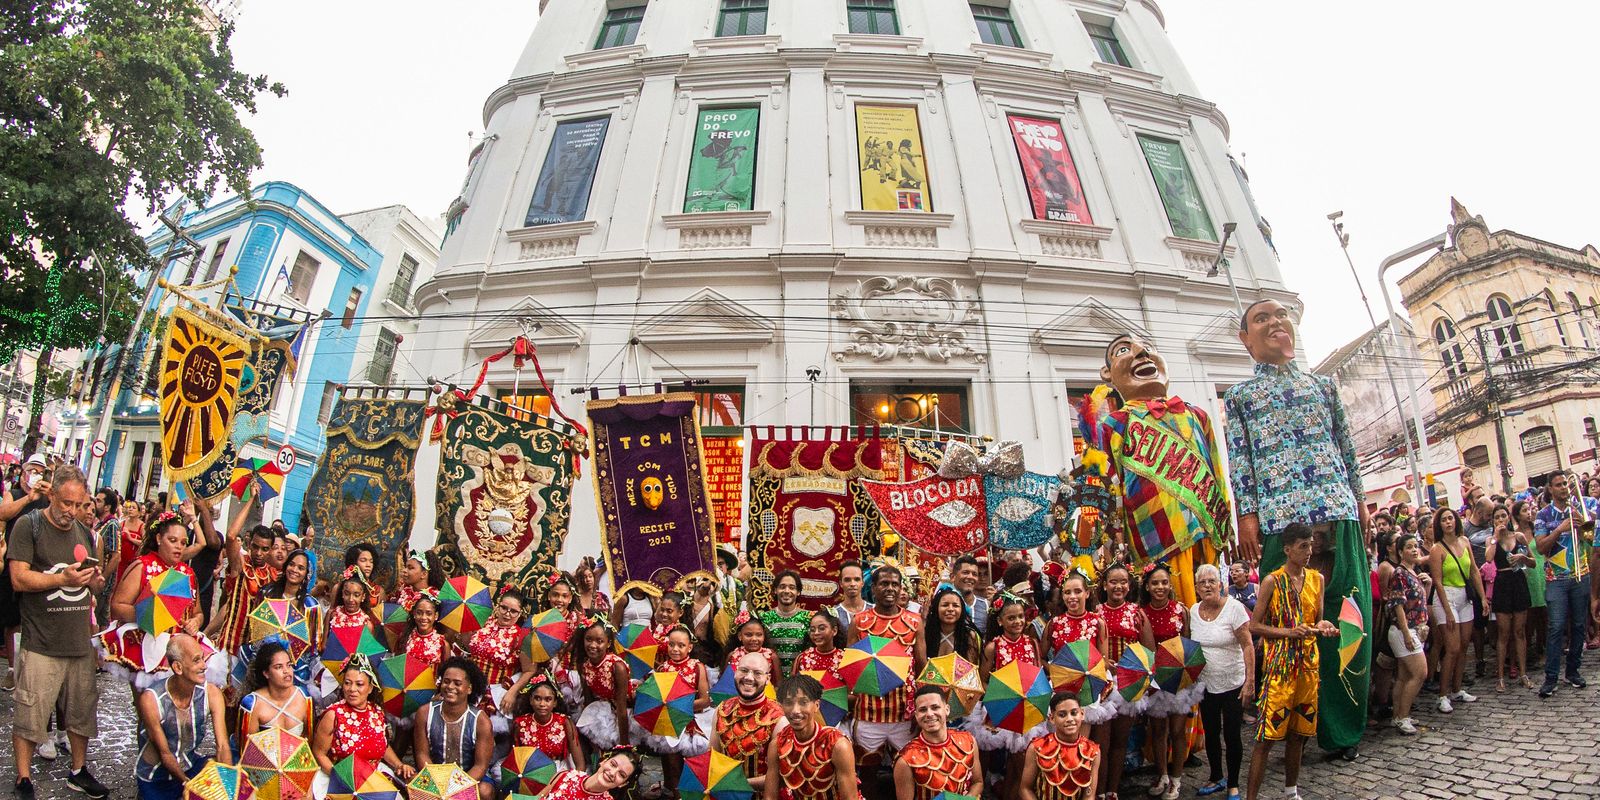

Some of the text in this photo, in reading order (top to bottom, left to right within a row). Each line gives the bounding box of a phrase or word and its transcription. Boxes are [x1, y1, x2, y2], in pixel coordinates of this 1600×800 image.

[704, 114, 736, 124] PAÇO
[710, 130, 750, 139] FREVO
[1020, 134, 1062, 152] VIVO
[192, 354, 217, 378] PIFE
[184, 366, 216, 390] FLOYD
[1124, 420, 1168, 468] SEU
[280, 451, 293, 465] 30
[363, 454, 385, 469] SABE
[626, 462, 678, 506] MEXE COM TUDO
[890, 481, 950, 510] BLOCO
[956, 479, 980, 497] DA
[640, 522, 676, 534] RECIFE
[967, 528, 984, 546] 19
[648, 535, 672, 546] 2019
